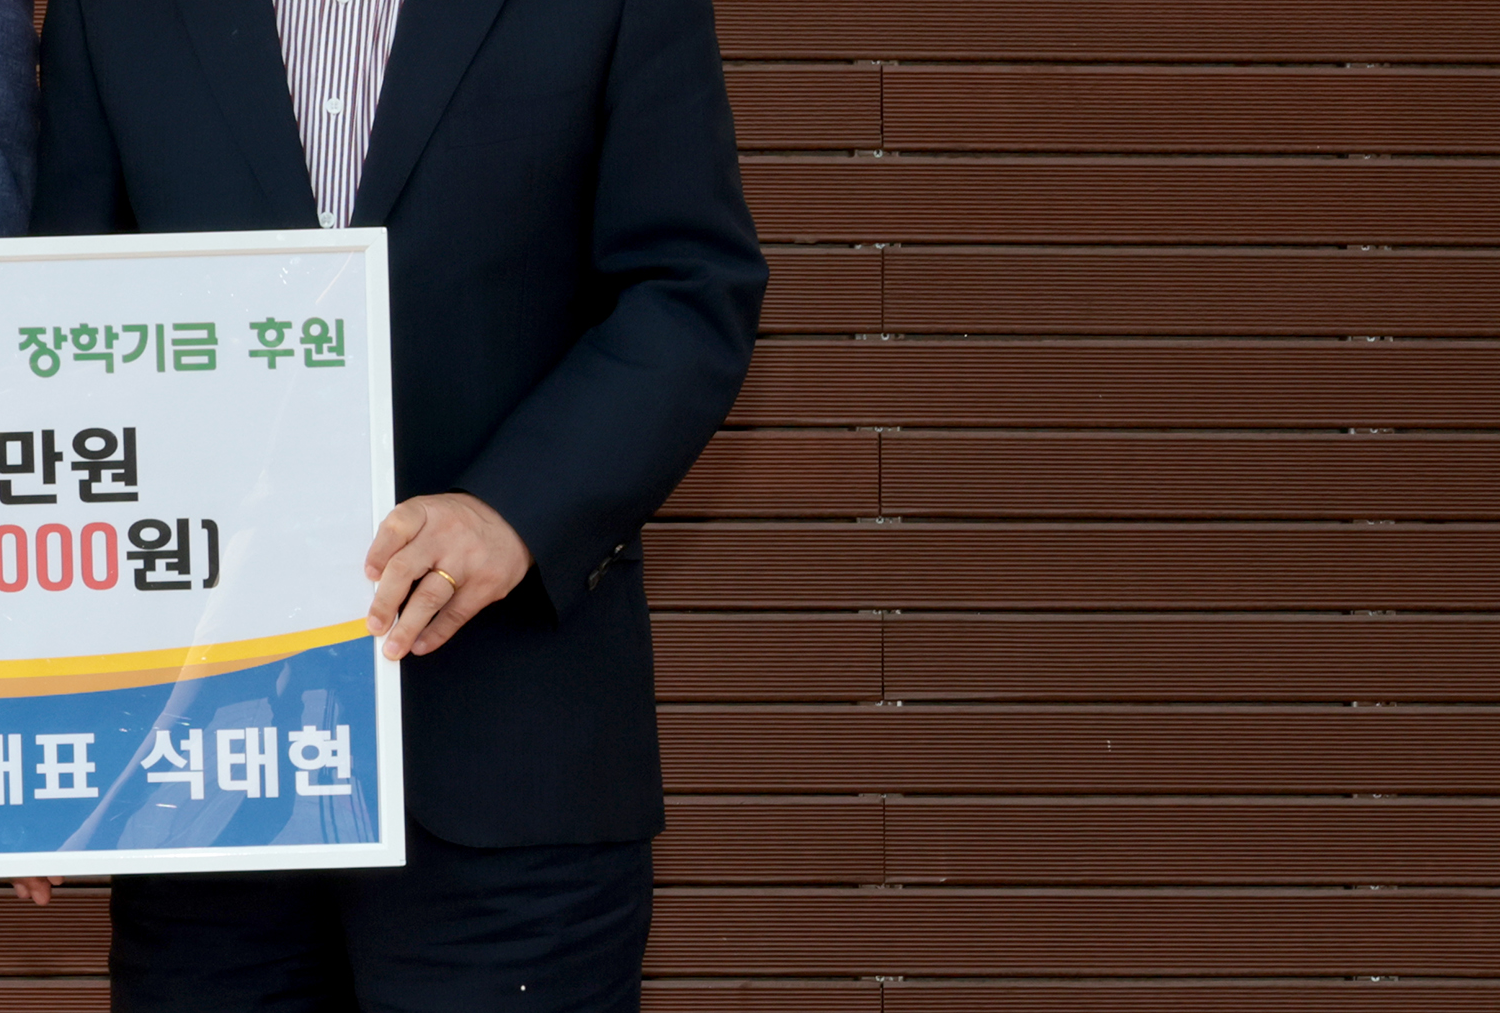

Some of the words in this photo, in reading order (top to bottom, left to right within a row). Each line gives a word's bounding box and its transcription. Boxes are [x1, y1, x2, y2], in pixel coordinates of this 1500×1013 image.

[18, 321, 219, 377] 장학기금
[248, 317, 348, 369] 후원
[140, 724, 354, 801] 석태현
